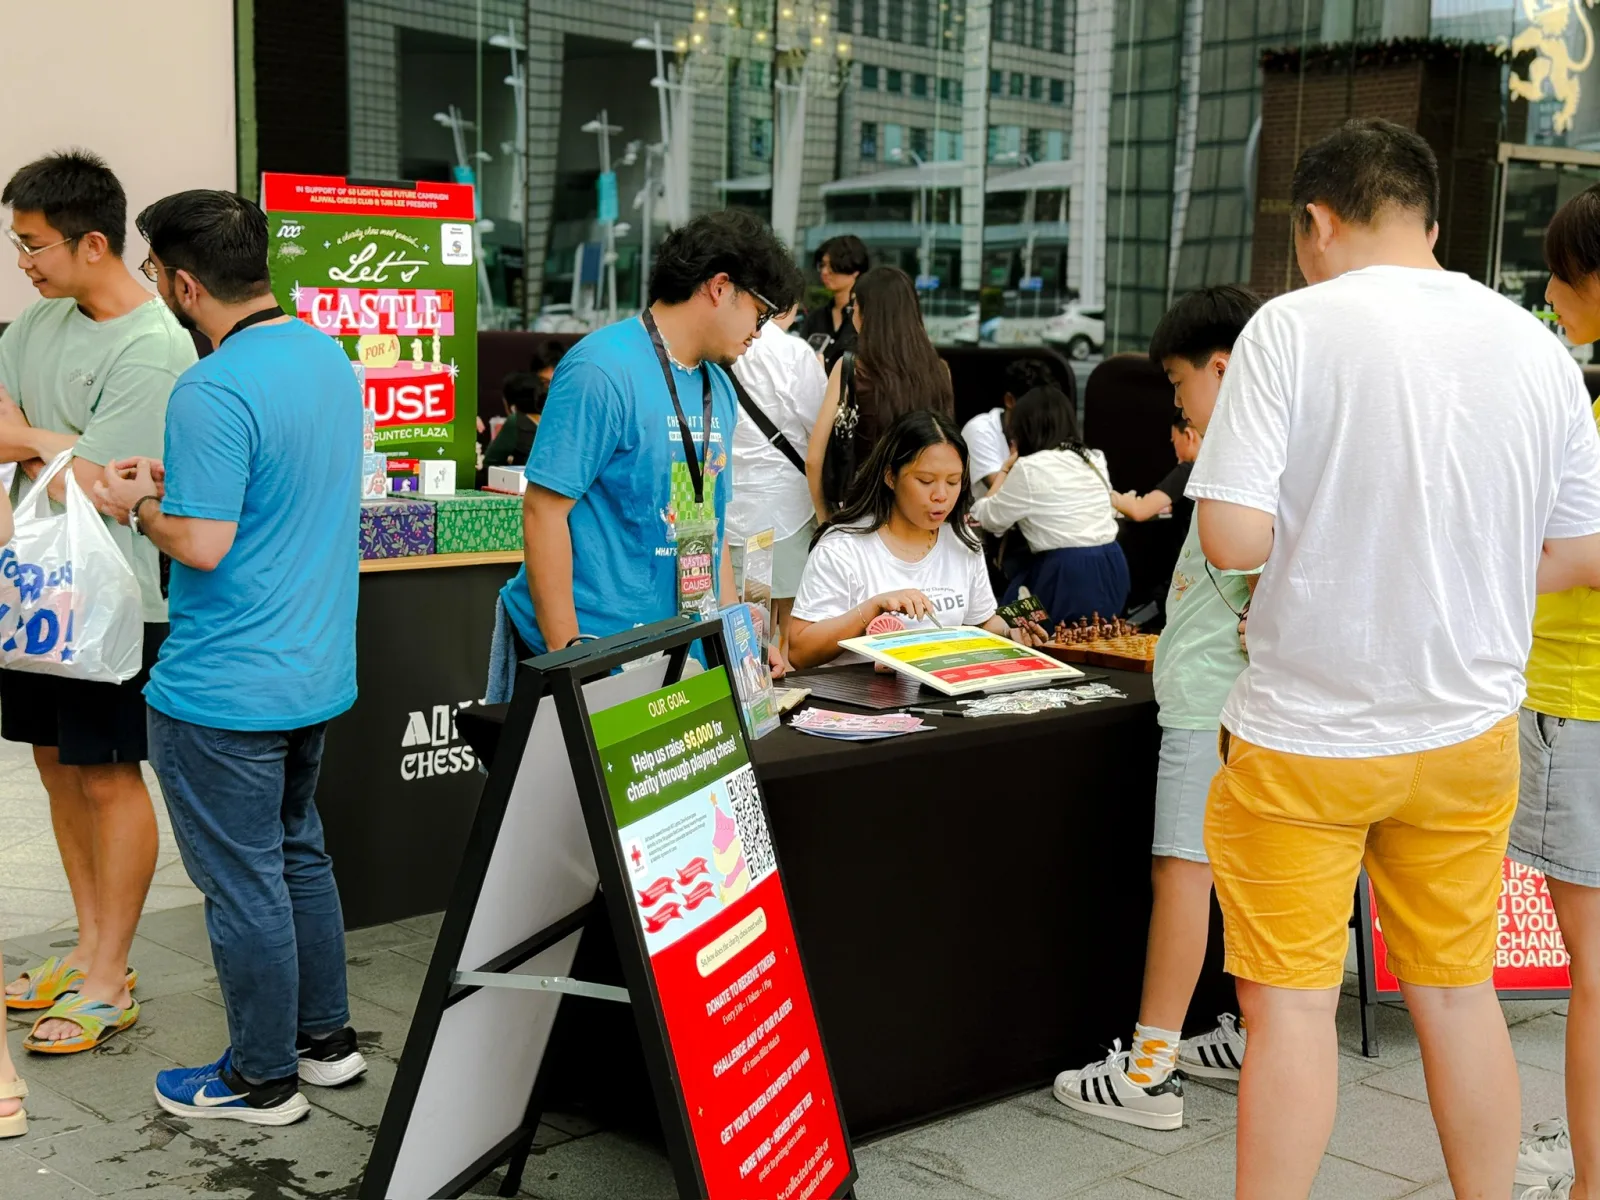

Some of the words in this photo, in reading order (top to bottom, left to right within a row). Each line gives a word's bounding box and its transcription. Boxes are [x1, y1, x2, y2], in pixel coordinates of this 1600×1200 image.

[305, 186, 336, 194] SUPPORT
[394, 191, 416, 199] FUTURE
[417, 192, 449, 200] CAMPAIGN
[406, 200, 438, 209] PRESENTS
[328, 242, 429, 283] Let's
[312, 292, 443, 329] CASTLE
[364, 343, 386, 361] FOR
[387, 339, 397, 352] A
[373, 428, 412, 442] SUNTEC
[414, 428, 448, 438] PLAZA
[683, 579, 710, 590] CAUSE
[648, 698, 668, 717] OUR
[667, 691, 690, 710] GOAL
[401, 745, 474, 780] CHESS
[631, 751, 654, 773] Help
[654, 747, 666, 762] us
[665, 738, 685, 759] raise
[684, 723, 713, 750] $6,000
[712, 720, 723, 737] for
[627, 775, 659, 801] charity
[659, 758, 692, 787] through
[690, 749, 718, 776] playing
[716, 735, 737, 757] chess!
[1493, 950, 1571, 967] BOARD
[706, 988, 732, 1017] DONATE
[729, 982, 740, 998] TO
[737, 965, 760, 992] RECEIVE
[757, 950, 776, 975] TOKENS
[723, 1010, 736, 1025] Every
[713, 1039, 748, 1078] CHALLENGE
[746, 1030, 758, 1050] ANY
[757, 1023, 764, 1040] OF
[764, 1015, 775, 1034] OUR
[773, 997, 793, 1025] PLAYERS
[721, 1123, 734, 1145] GET
[732, 1109, 750, 1134] YOUR
[748, 1092, 768, 1119] TOKEN
[766, 1071, 789, 1103] STAMPED
[787, 1065, 793, 1080] IF
[791, 1056, 801, 1075] YOU
[800, 1047, 810, 1066] WIN
[739, 1152, 758, 1179] MORE
[755, 1137, 771, 1162] WINS
[773, 1116, 792, 1144] HIGHER
[789, 1102, 804, 1126] PRIZE
[801, 1091, 813, 1111] TIER
[785, 1160, 809, 1198] collected
[823, 1137, 829, 1152] or
